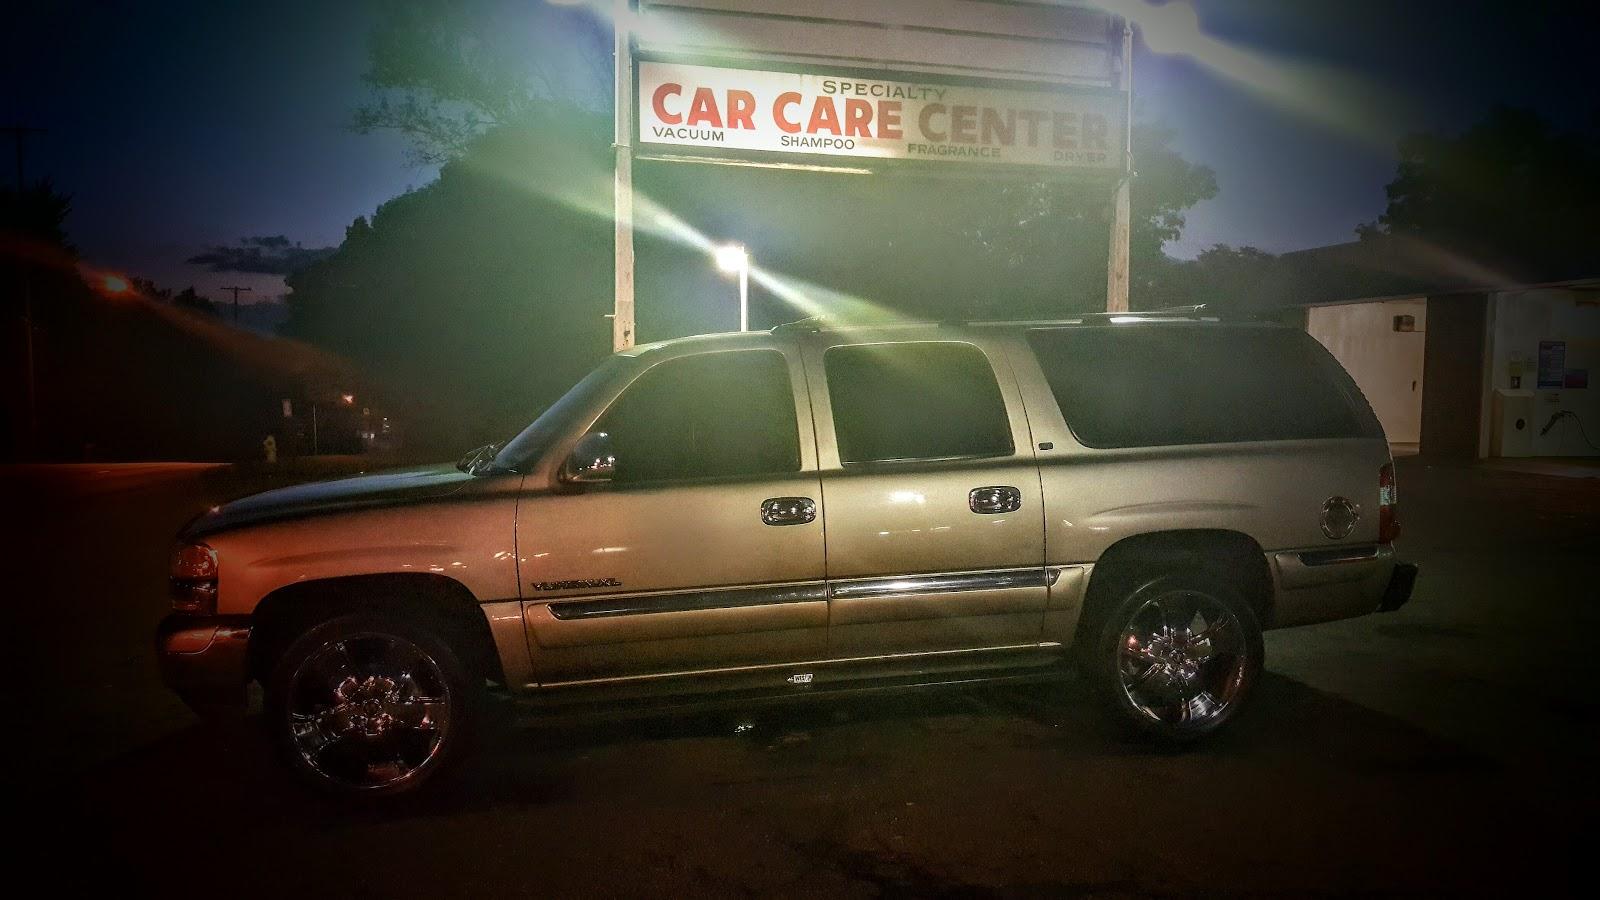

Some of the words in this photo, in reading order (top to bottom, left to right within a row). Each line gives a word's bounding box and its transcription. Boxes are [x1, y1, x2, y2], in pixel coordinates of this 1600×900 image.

[823, 80, 947, 101] SPECIALTY
[652, 82, 756, 130] CAR
[772, 91, 903, 140] CARE
[918, 102, 1108, 150] CENTER
[652, 126, 725, 142] VACUUM
[781, 135, 855, 150] SHAMPOO
[908, 143, 1002, 158] FRAGRANCE
[1054, 150, 1107, 163] DRYER
